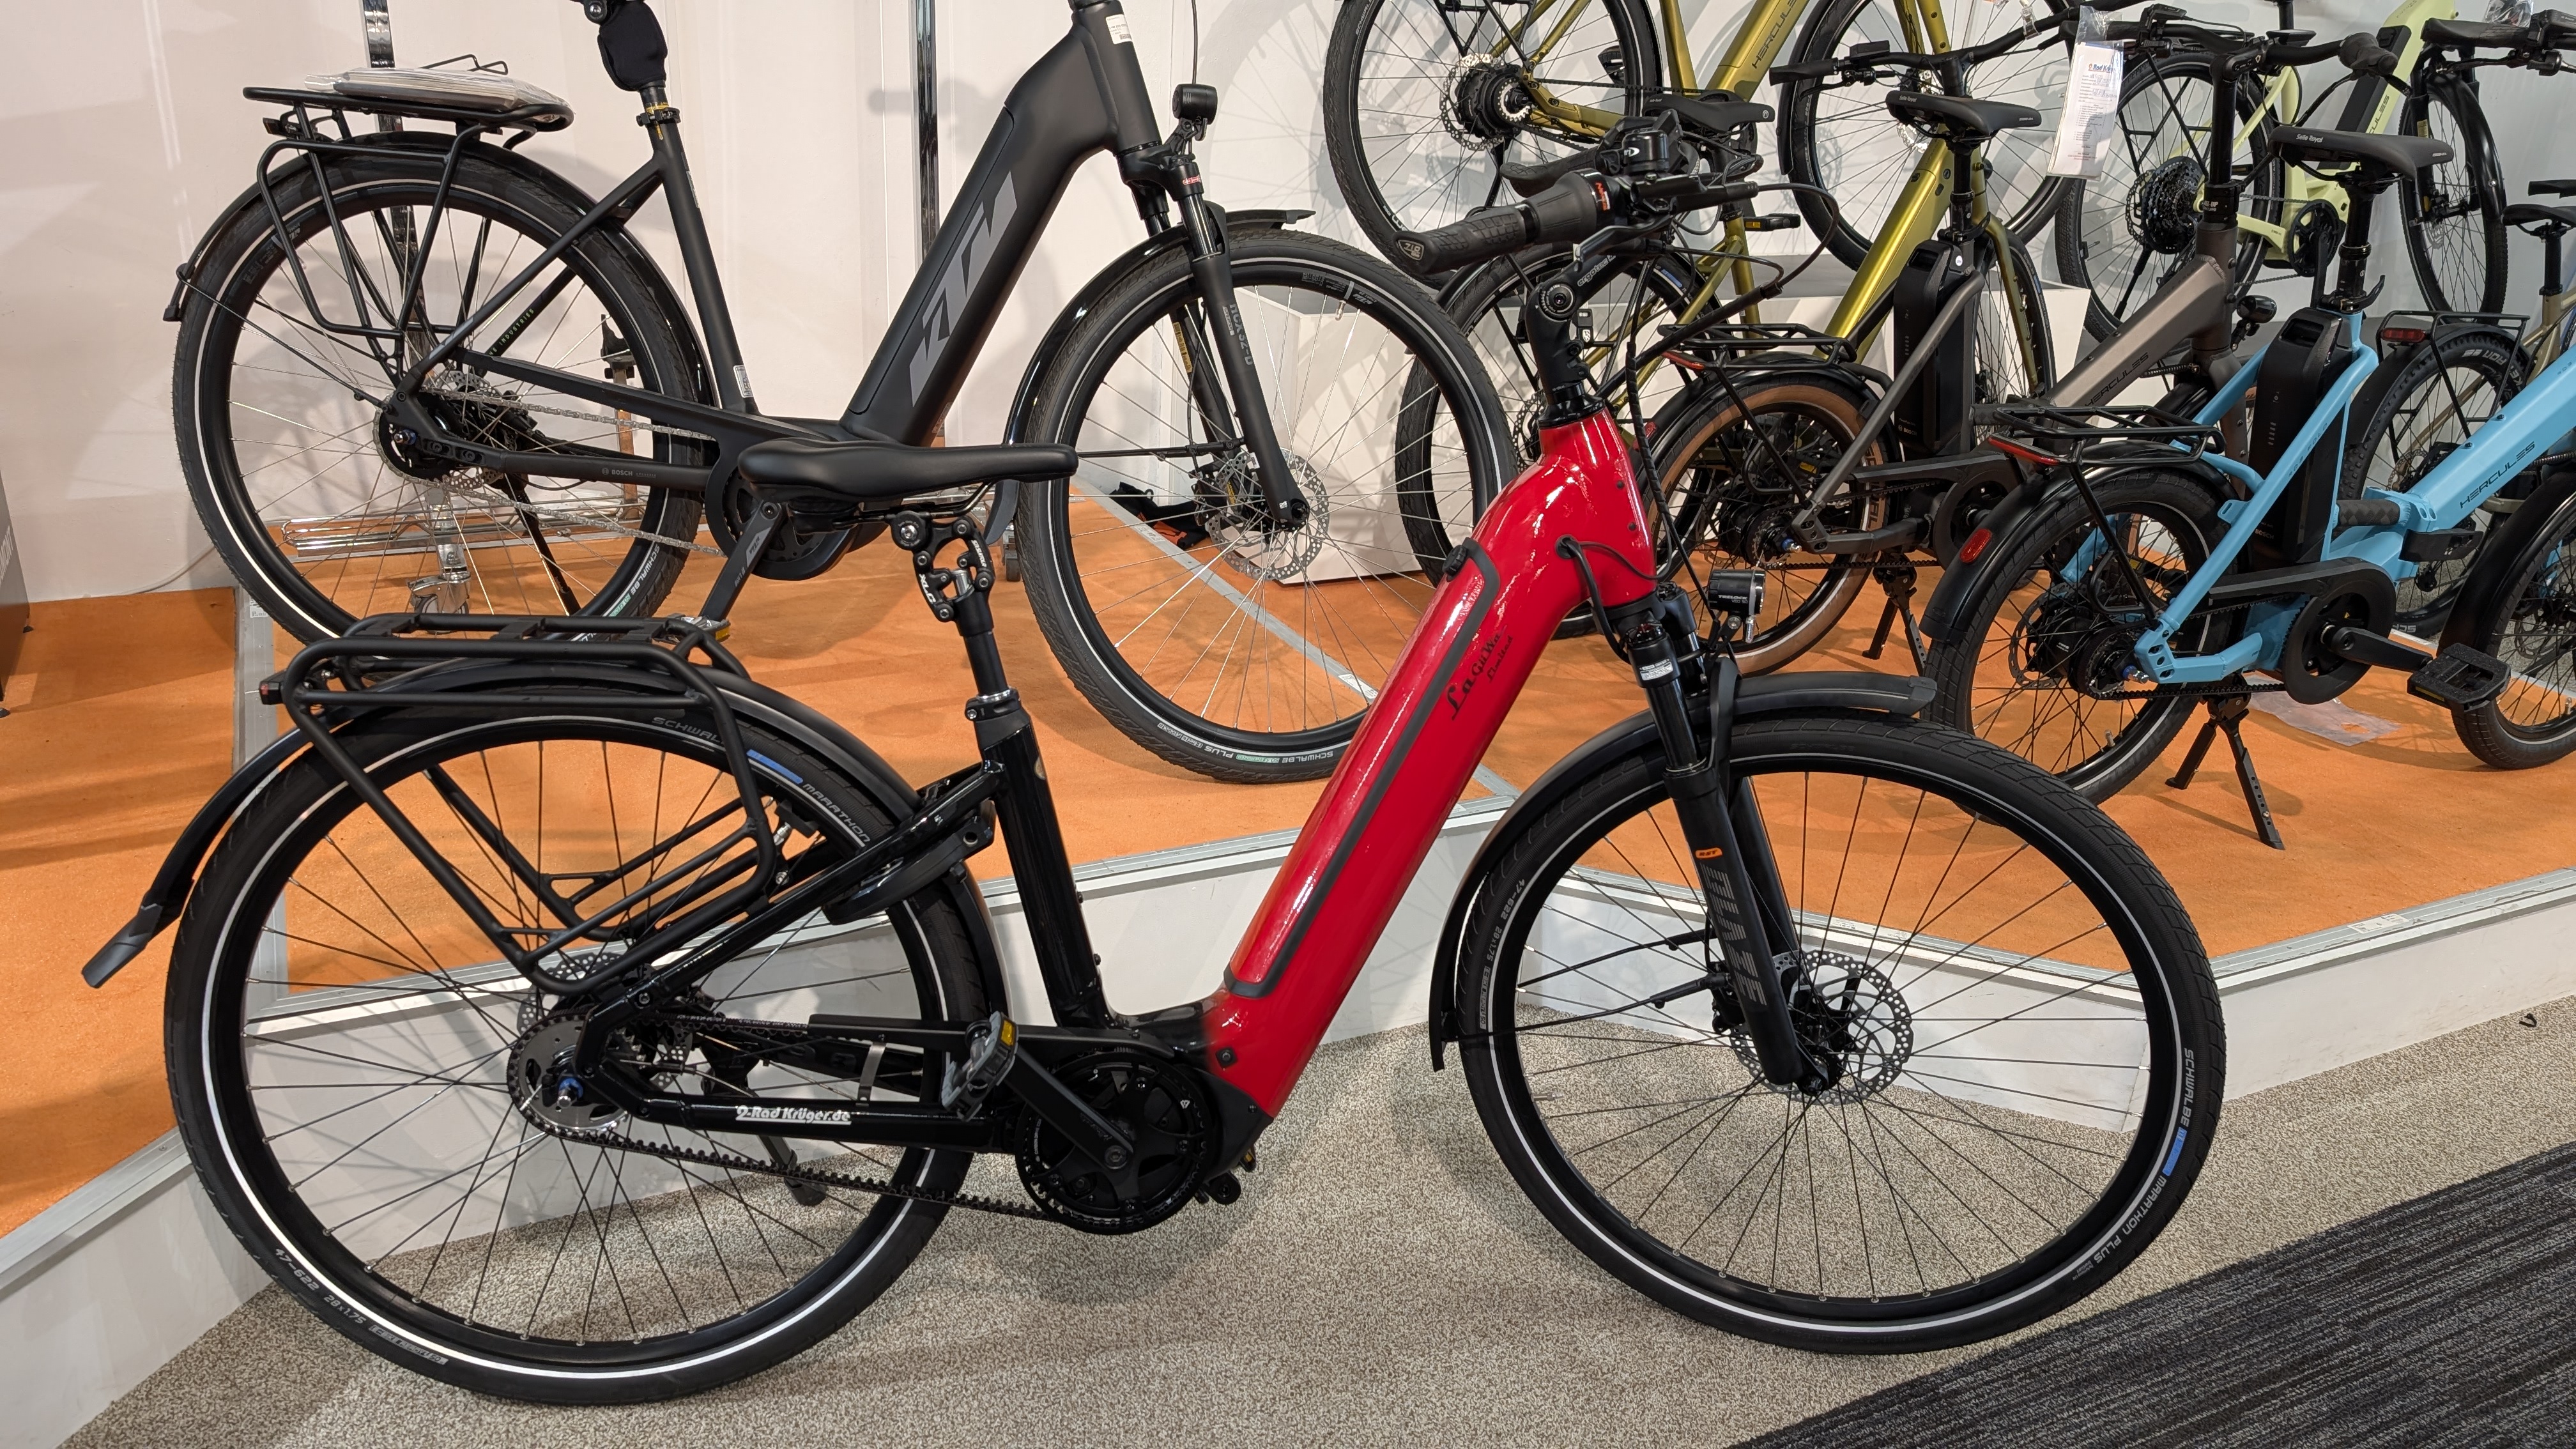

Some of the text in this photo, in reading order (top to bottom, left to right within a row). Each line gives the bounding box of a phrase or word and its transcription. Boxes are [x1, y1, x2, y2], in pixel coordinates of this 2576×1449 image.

[1356, 0, 1374, 35] SCHWAL
[909, 171, 1018, 408] KTM
[1577, 258, 1608, 287] ergotec
[498, 308, 535, 346] INDUSTRIES
[2084, 351, 2149, 407] HERCULES
[611, 468, 633, 477] BOSCH
[2460, 441, 2535, 509] HERCULES
[2255, 528, 2274, 540] BOSCH
[631, 544, 660, 595] SCHWALBE
[918, 573, 937, 604] XLC
[652, 716, 725, 744] SCHWAL
[1204, 746, 1234, 759] PLUS
[1282, 751, 1334, 763] SCHWALBE
[802, 783, 871, 843] MARATHON
[1500, 878, 1526, 920] 47-622
[2180, 1048, 2195, 1128] SCHWALBE
[737, 1105, 851, 1124] 2-Rad Krüger.de
[2094, 1175, 2167, 1264] MARATHON PLUS
[275, 1248, 320, 1291] 47-622
